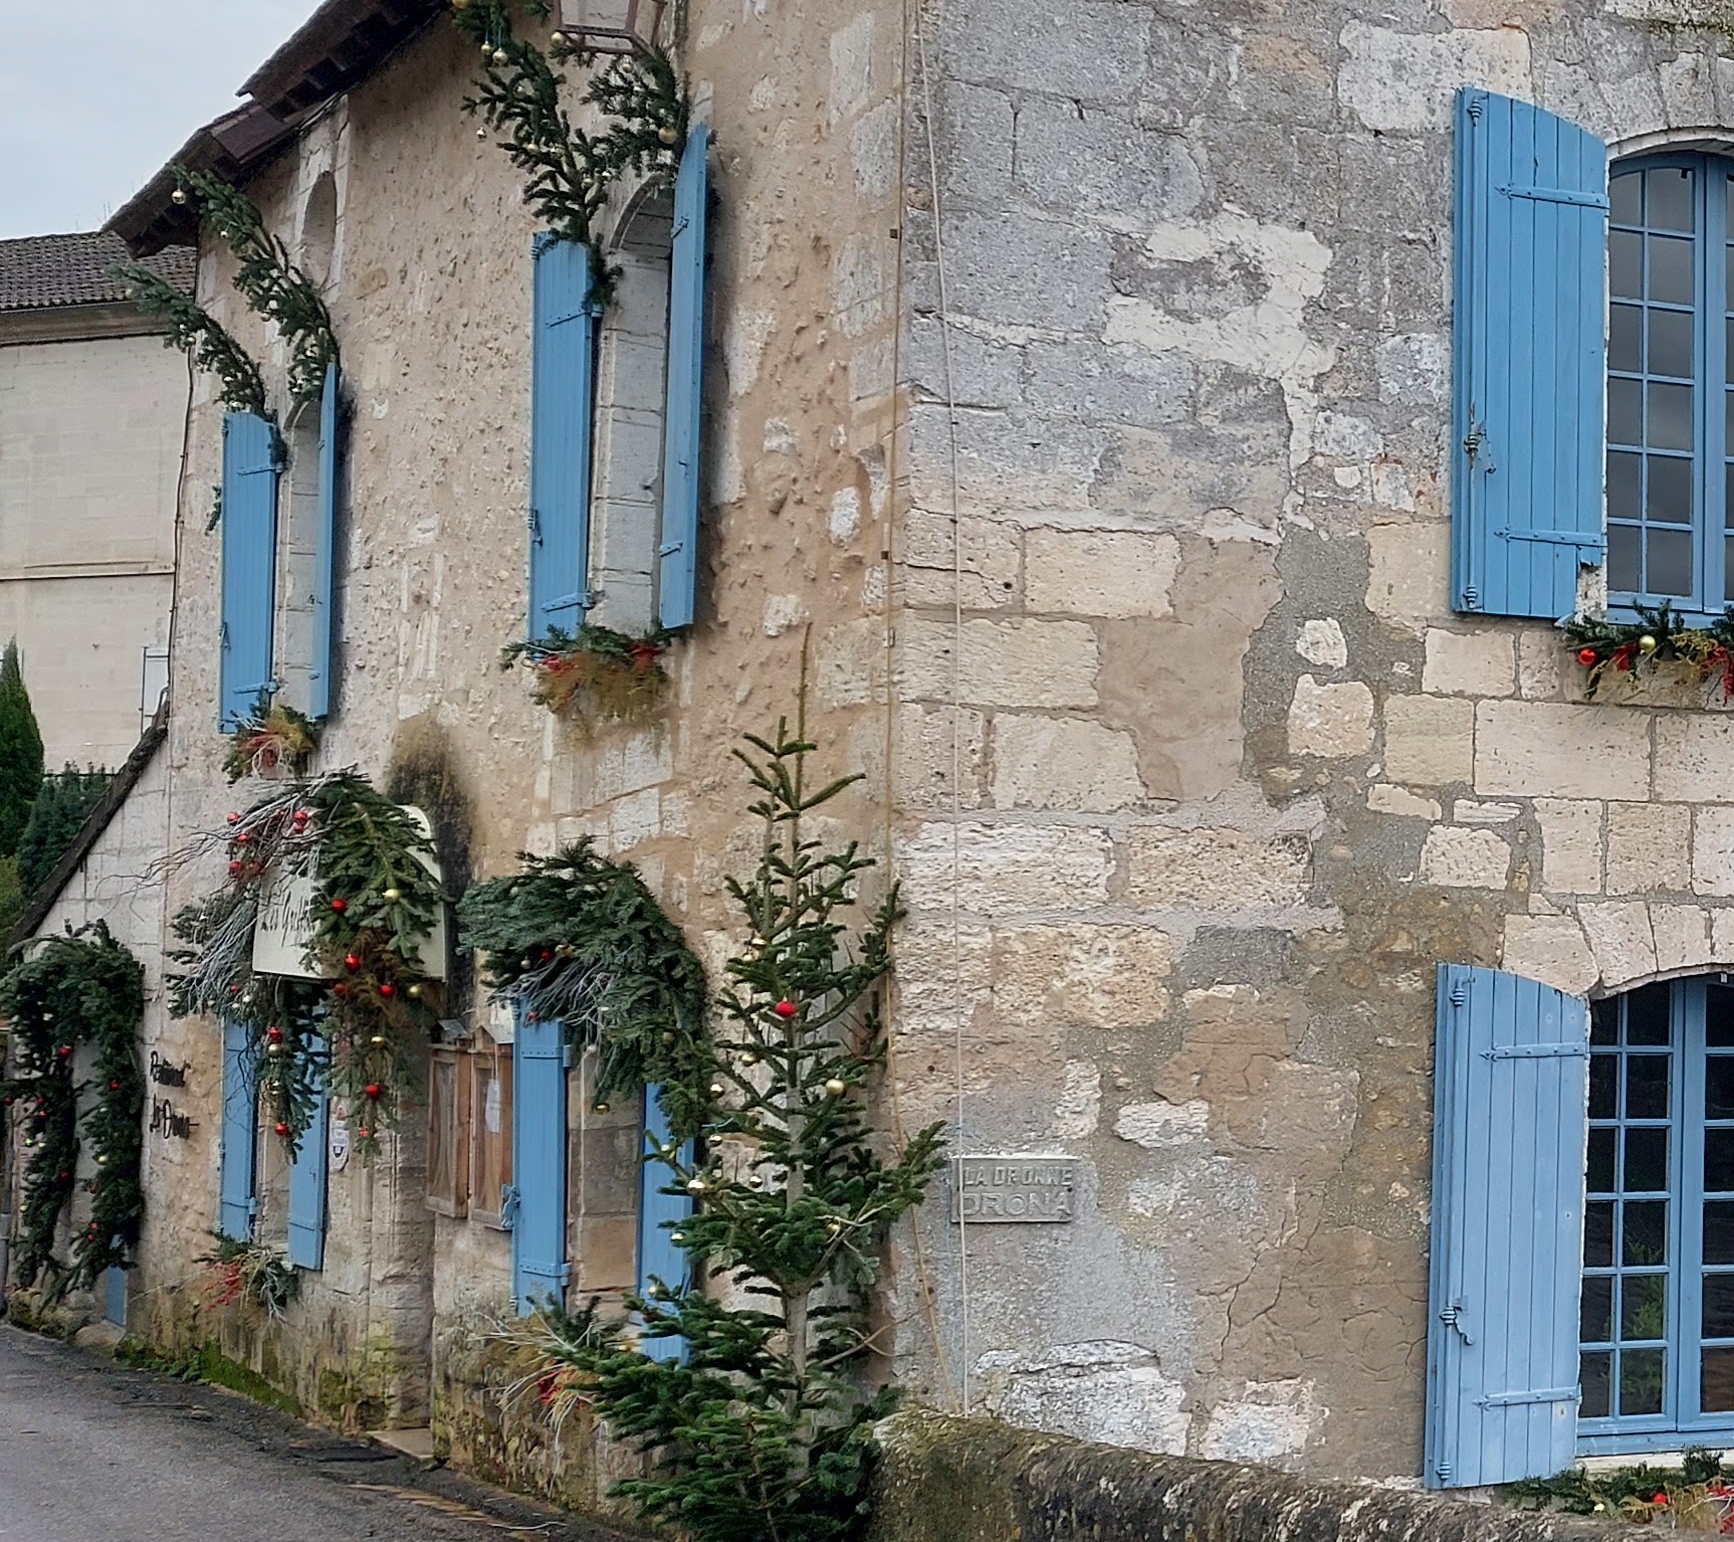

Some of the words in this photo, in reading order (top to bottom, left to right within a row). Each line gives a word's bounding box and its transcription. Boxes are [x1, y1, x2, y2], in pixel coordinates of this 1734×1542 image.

[964, 1166, 988, 1187] LA
[993, 1165, 1073, 1187] DRONNE
[959, 1191, 1073, 1216] DRONA
